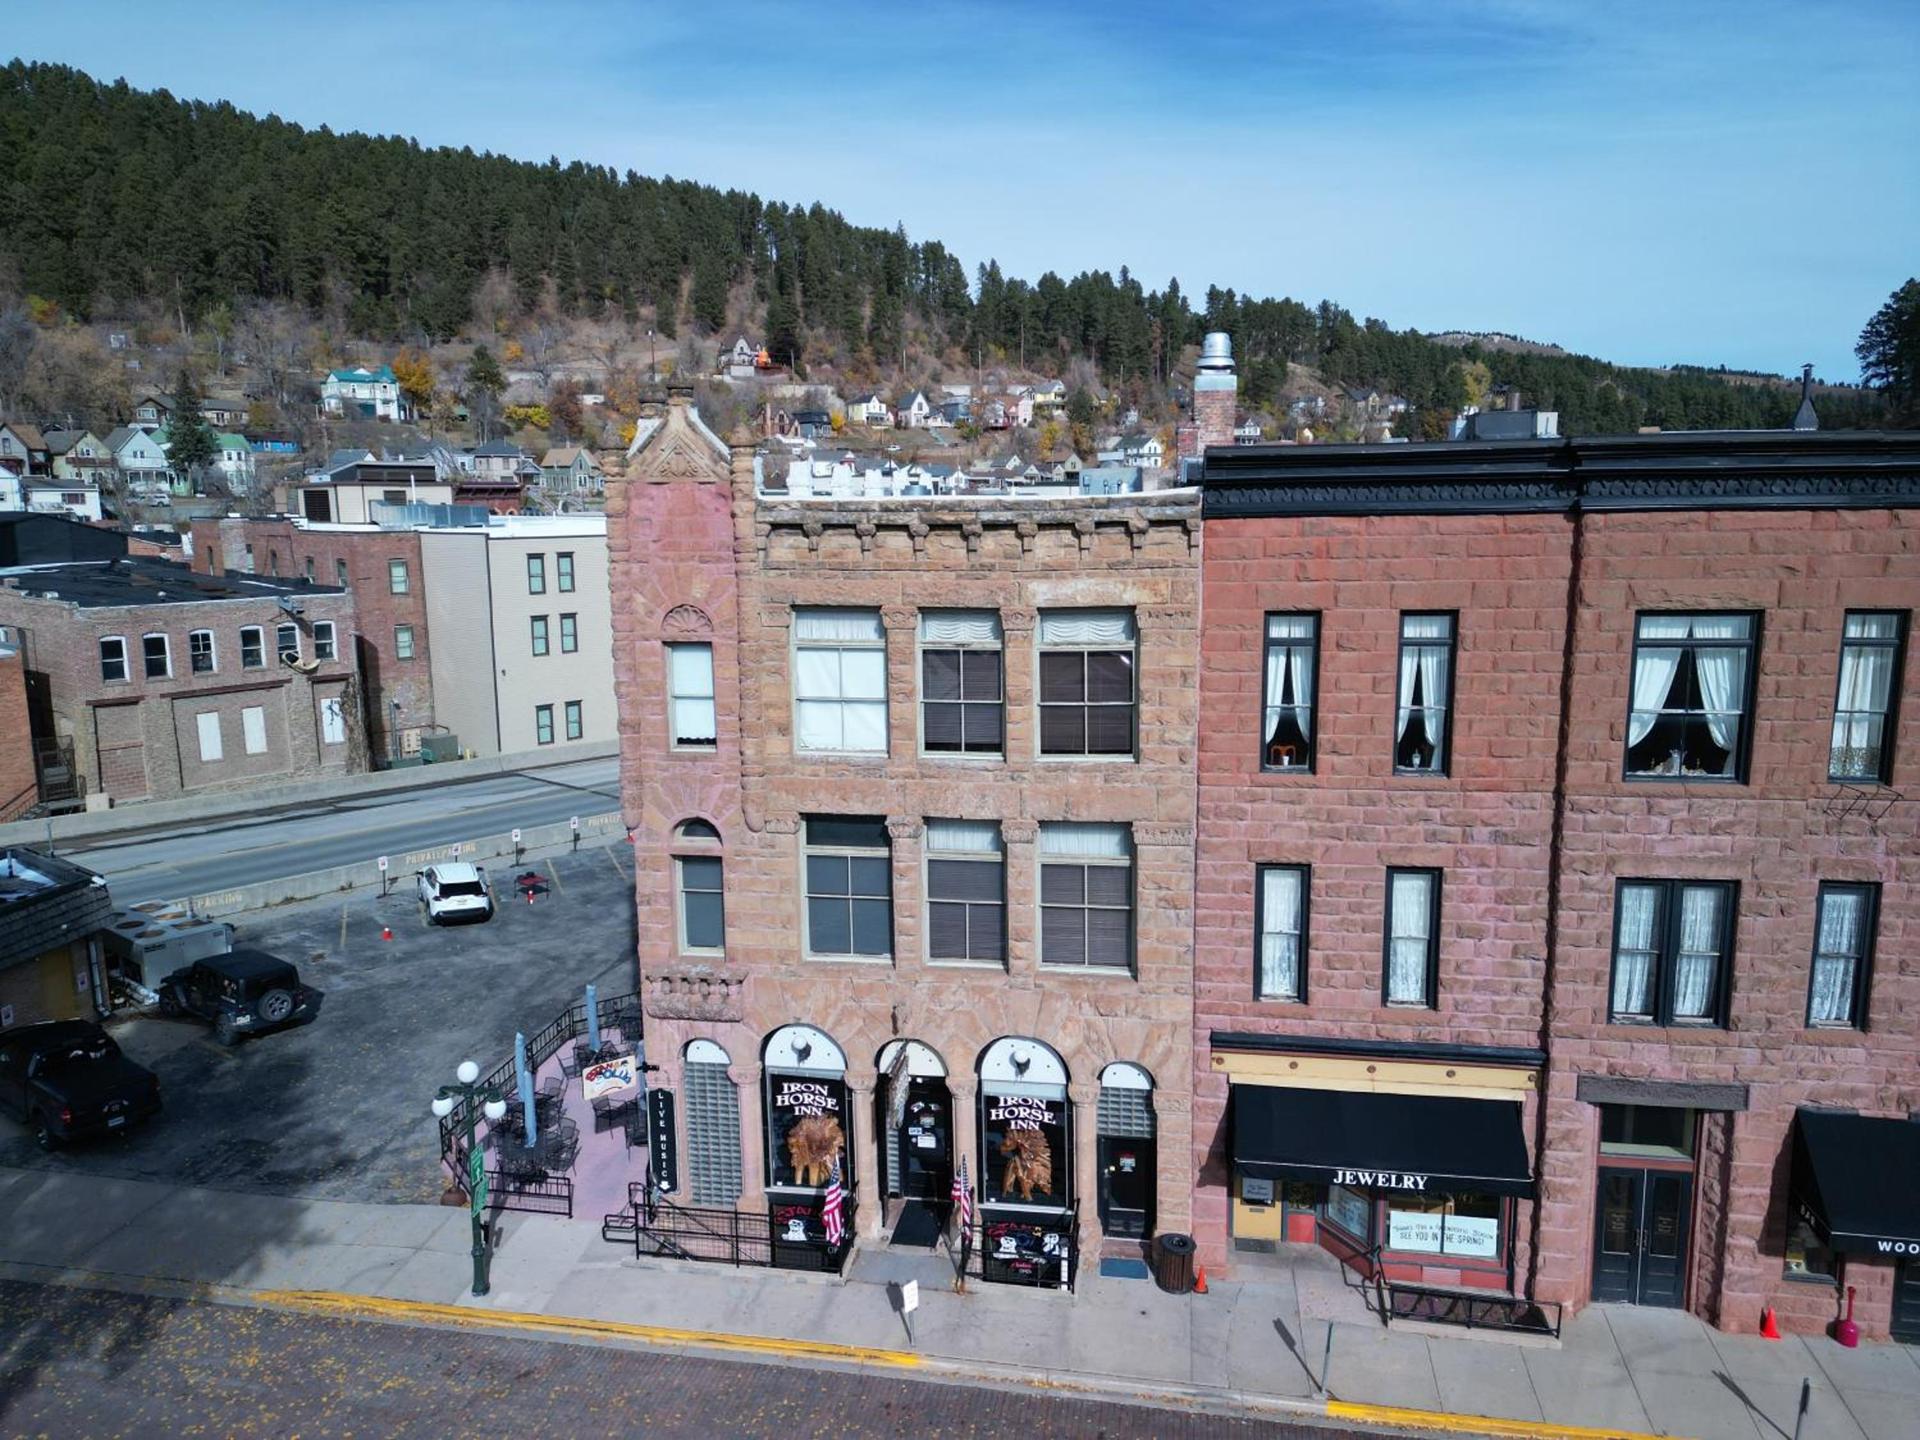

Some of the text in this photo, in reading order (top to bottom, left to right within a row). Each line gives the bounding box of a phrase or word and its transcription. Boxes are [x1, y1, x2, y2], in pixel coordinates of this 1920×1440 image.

[782, 1082, 828, 1096] IRON
[776, 1093, 839, 1111] HORSE
[998, 1096, 1046, 1110] IRON
[794, 1105, 822, 1116] INN
[990, 1107, 1056, 1124] HORSE
[1010, 1119, 1040, 1130] INN
[658, 1092, 668, 1177] LIVE MUSIC
[1333, 1170, 1428, 1190] JEWELRY
